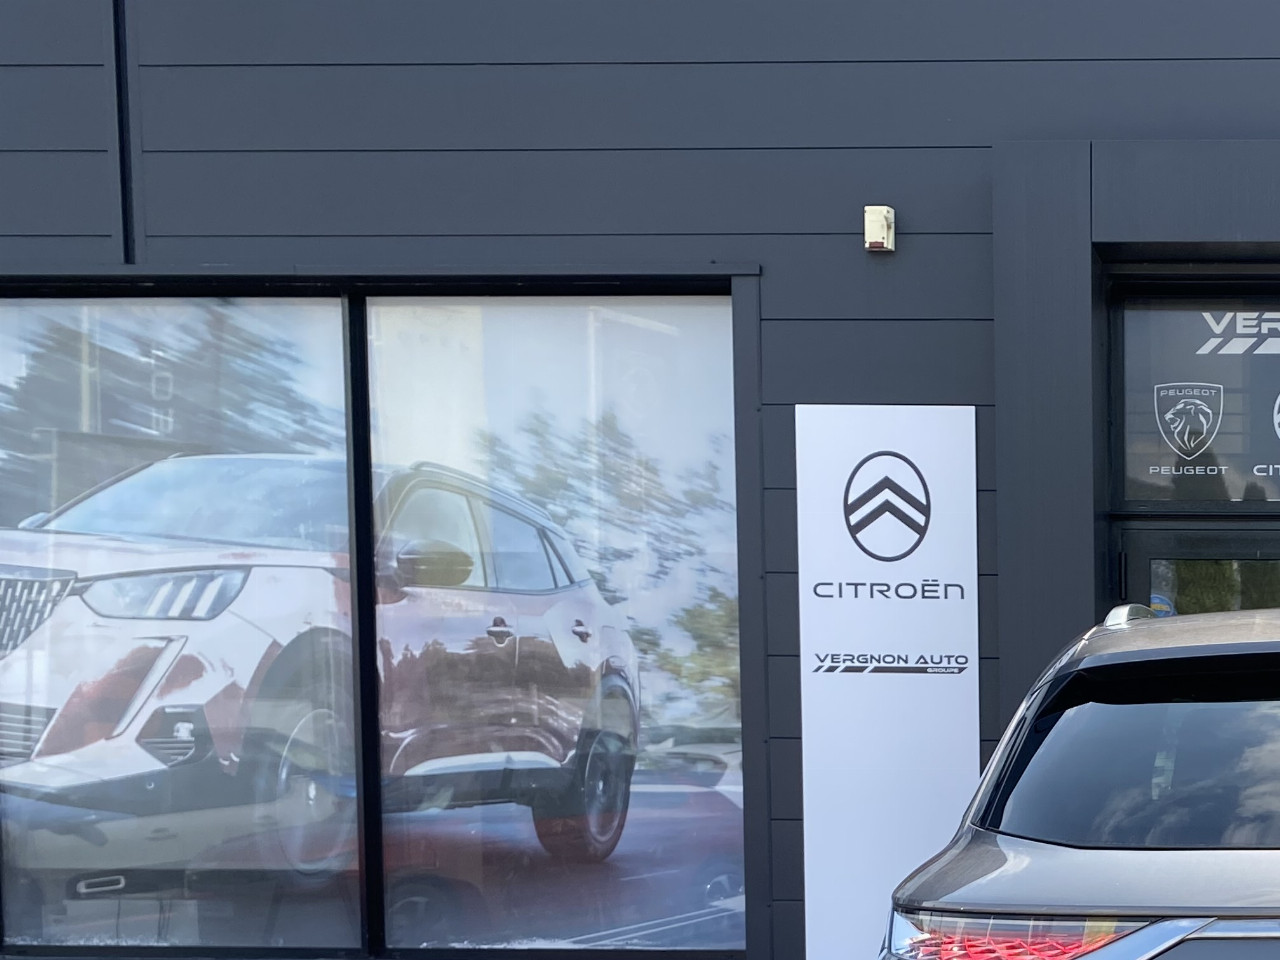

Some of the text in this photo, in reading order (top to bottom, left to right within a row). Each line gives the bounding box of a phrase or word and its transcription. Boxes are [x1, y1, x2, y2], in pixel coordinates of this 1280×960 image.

[1160, 388, 1217, 398] PEUGEOT
[1149, 465, 1229, 475] PEUGEOT
[814, 653, 969, 665] VERGNON AUTO
